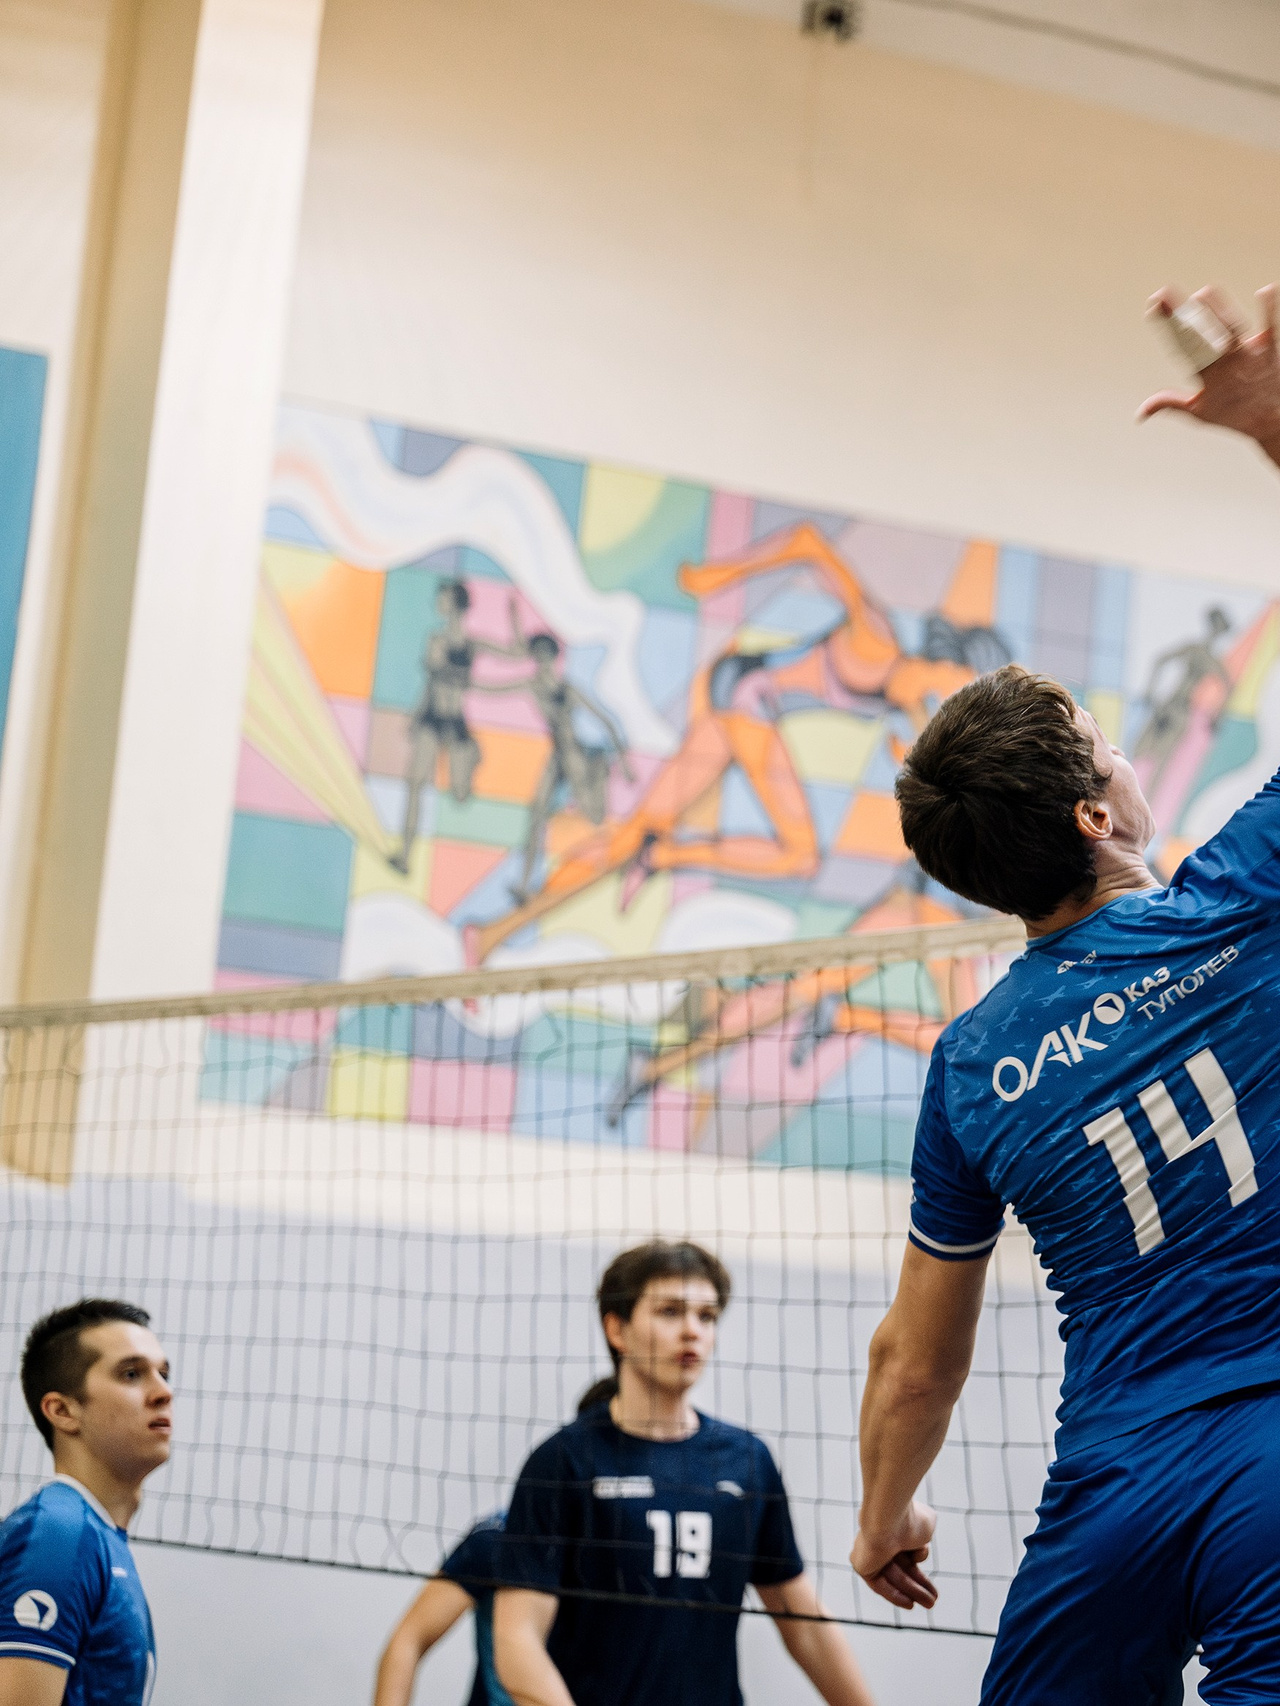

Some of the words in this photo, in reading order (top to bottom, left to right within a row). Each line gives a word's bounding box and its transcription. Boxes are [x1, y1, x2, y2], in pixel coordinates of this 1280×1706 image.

[1122, 966, 1171, 1003] КАЗ
[1136, 945, 1240, 1021] ТУПОЛЕВ
[1082, 1046, 1260, 1257] 14
[645, 1509, 713, 1579] 19
